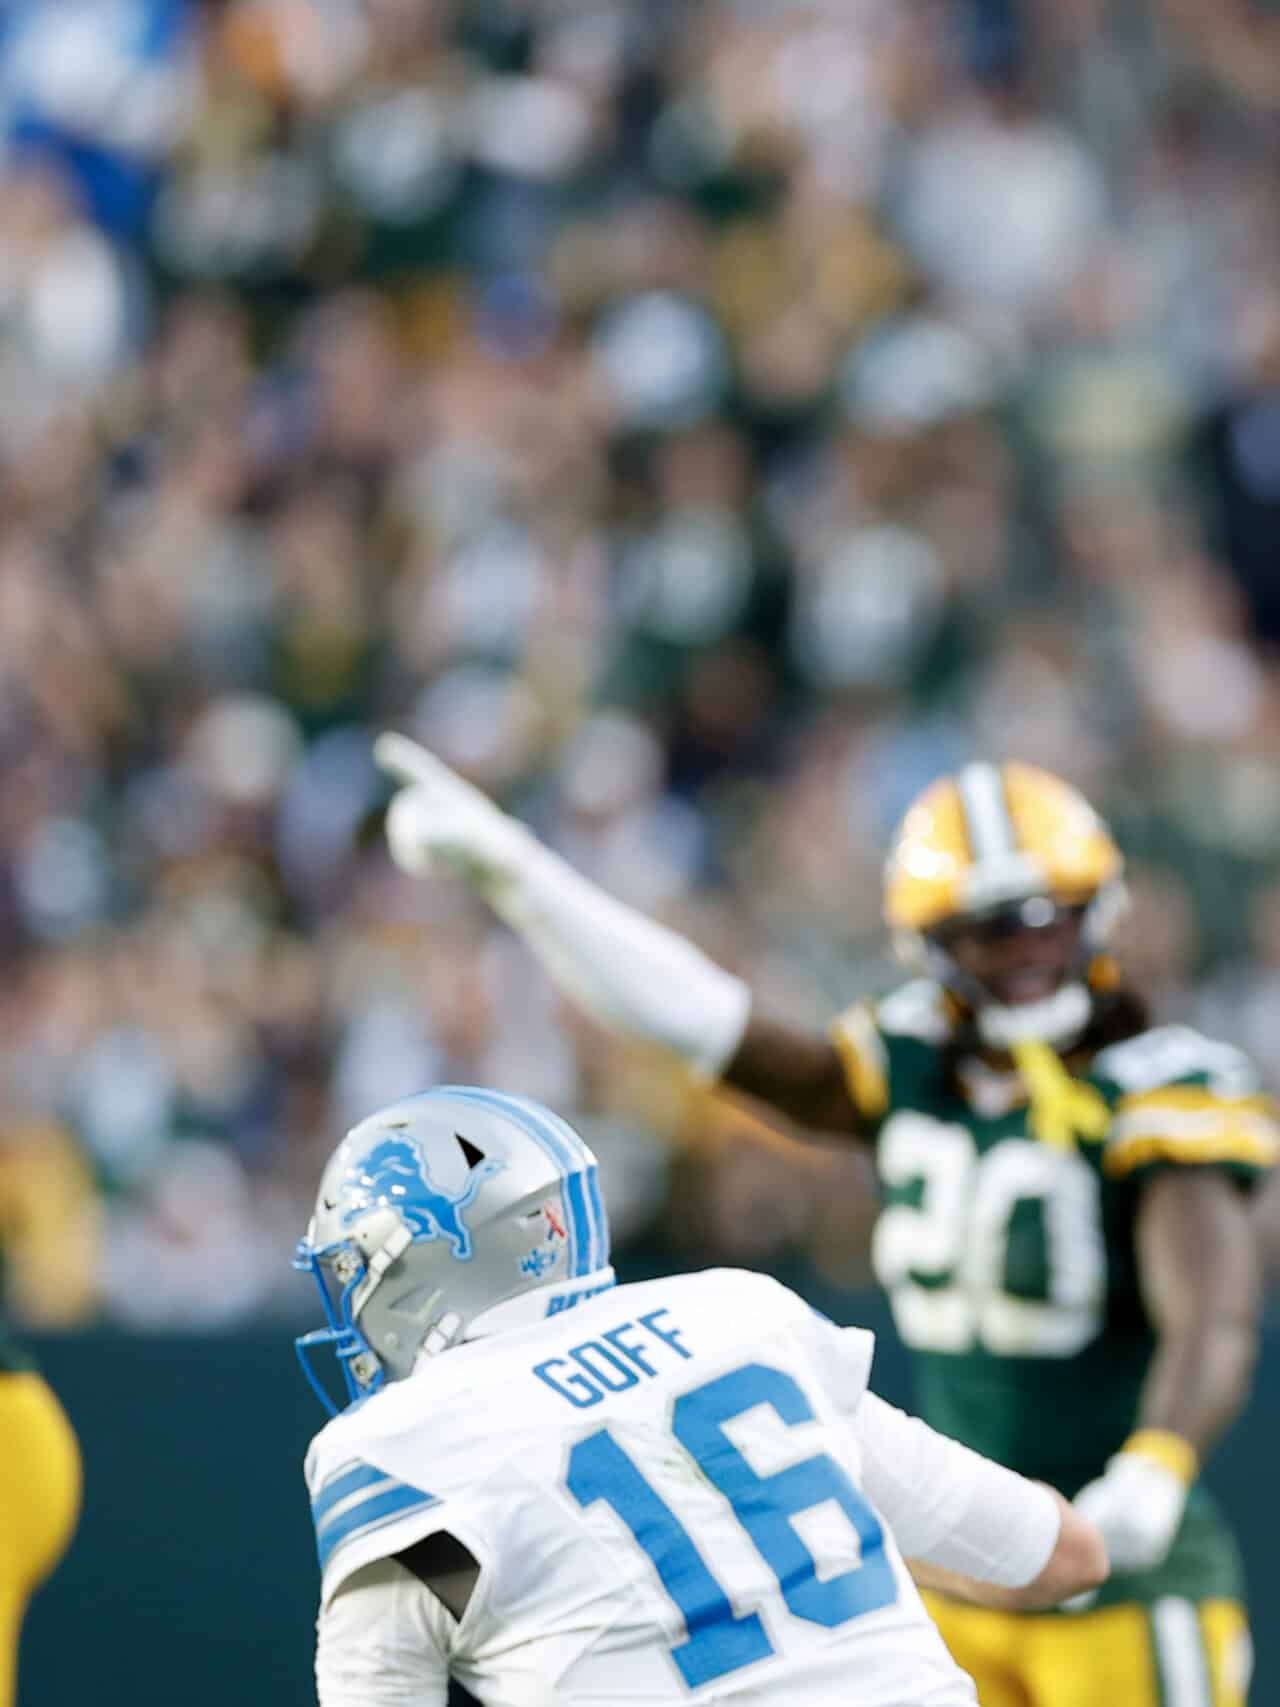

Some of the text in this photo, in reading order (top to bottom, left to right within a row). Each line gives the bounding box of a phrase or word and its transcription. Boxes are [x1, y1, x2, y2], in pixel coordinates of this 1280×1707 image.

[872, 1108, 1107, 1358] 20
[532, 1309, 692, 1408] GOFF
[566, 1362, 898, 1689] 16
